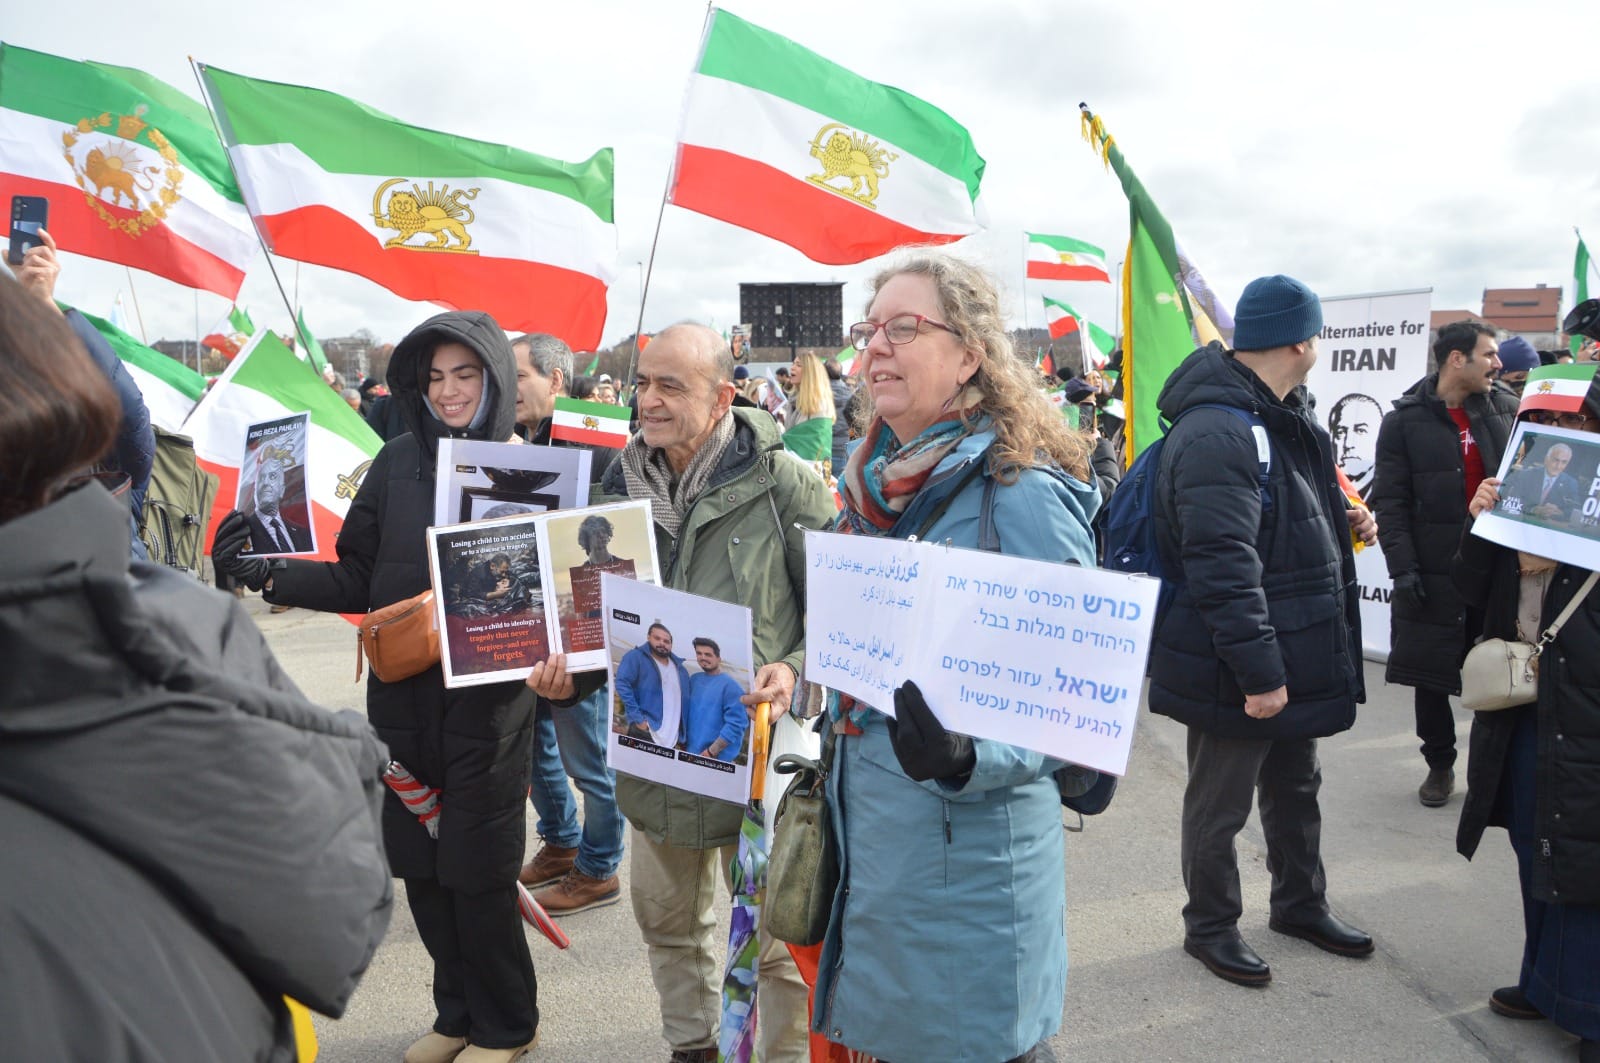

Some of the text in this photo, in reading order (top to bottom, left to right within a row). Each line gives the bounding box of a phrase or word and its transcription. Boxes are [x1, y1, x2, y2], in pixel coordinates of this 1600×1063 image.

[1318, 320, 1425, 340] lternative for
[1331, 348, 1396, 372] IRAN
[249, 430, 263, 438] KING
[1502, 499, 1524, 511] TALK
[477, 537, 493, 545] child
[510, 531, 536, 540] accident
[945, 575, 1141, 621] כורש הפרסי שחרר את
[511, 618, 535, 627] ideology
[469, 633, 494, 643] tragedy
[973, 608, 1136, 654] היהודים מגלות בבל.
[520, 639, 539, 647] never
[493, 650, 526, 662] forgets.
[942, 655, 1128, 704] ישראל, עזור לפרסים
[960, 685, 1122, 739] להגיע לחירות עכשיו!
